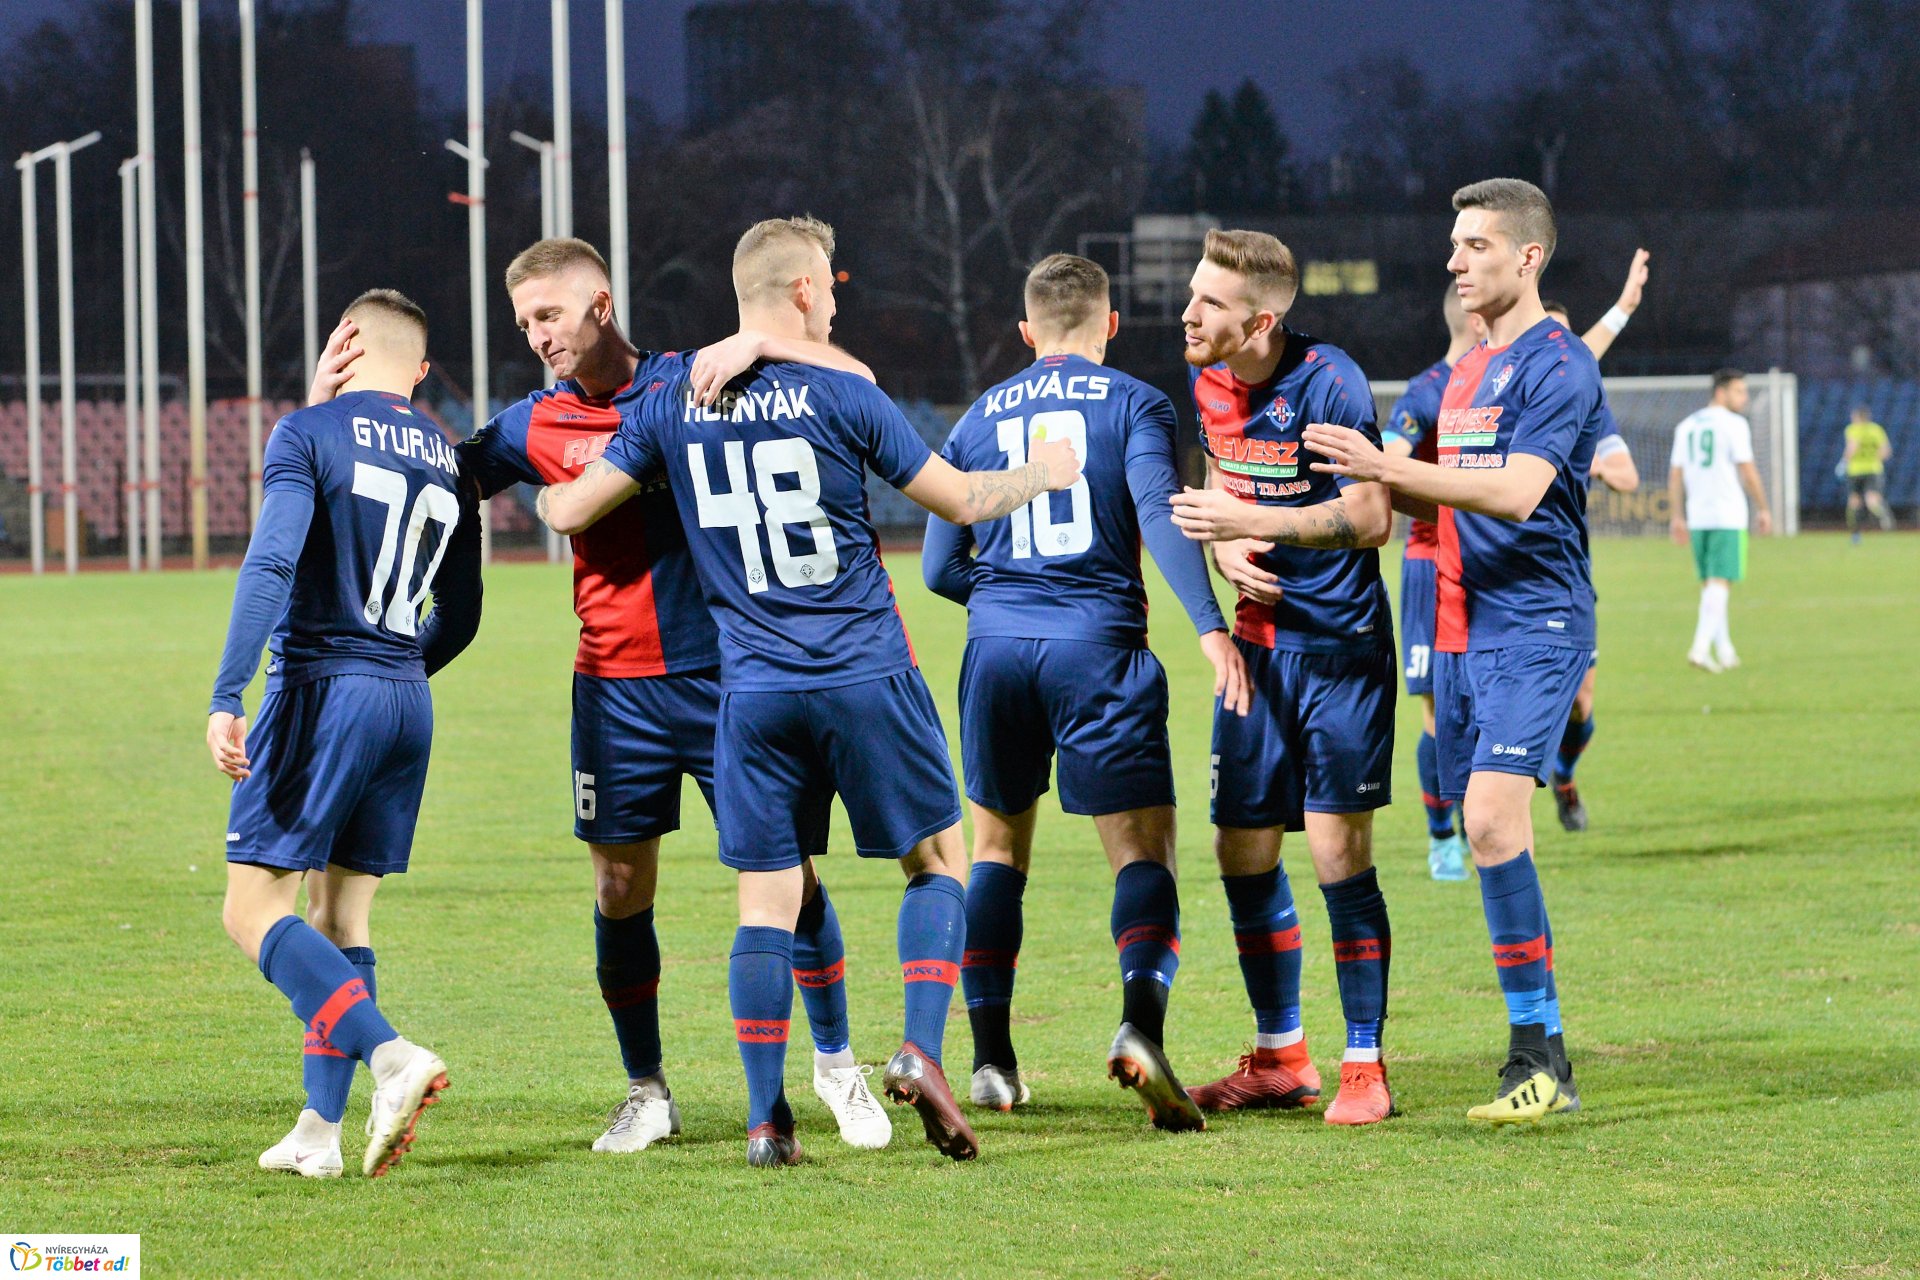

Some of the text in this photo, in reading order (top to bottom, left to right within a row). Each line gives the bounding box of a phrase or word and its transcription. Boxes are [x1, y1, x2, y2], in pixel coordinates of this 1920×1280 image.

[984, 370, 1111, 418] KOVÁCS
[352, 416, 461, 478] GYURJÁN
[1207, 432, 1299, 467] REVESZ
[1461, 453, 1504, 468] TRANS
[1687, 428, 1714, 469] 19
[996, 409, 1093, 560] 18
[1250, 465, 1260, 473] THE
[1257, 480, 1311, 496] TRANS
[687, 436, 840, 595] 48
[351, 460, 460, 637] 70
[1406, 644, 1430, 678] 31
[1504, 746, 1528, 756] JAKO
[575, 769, 596, 821] 16
[739, 1025, 784, 1037] JAKO
